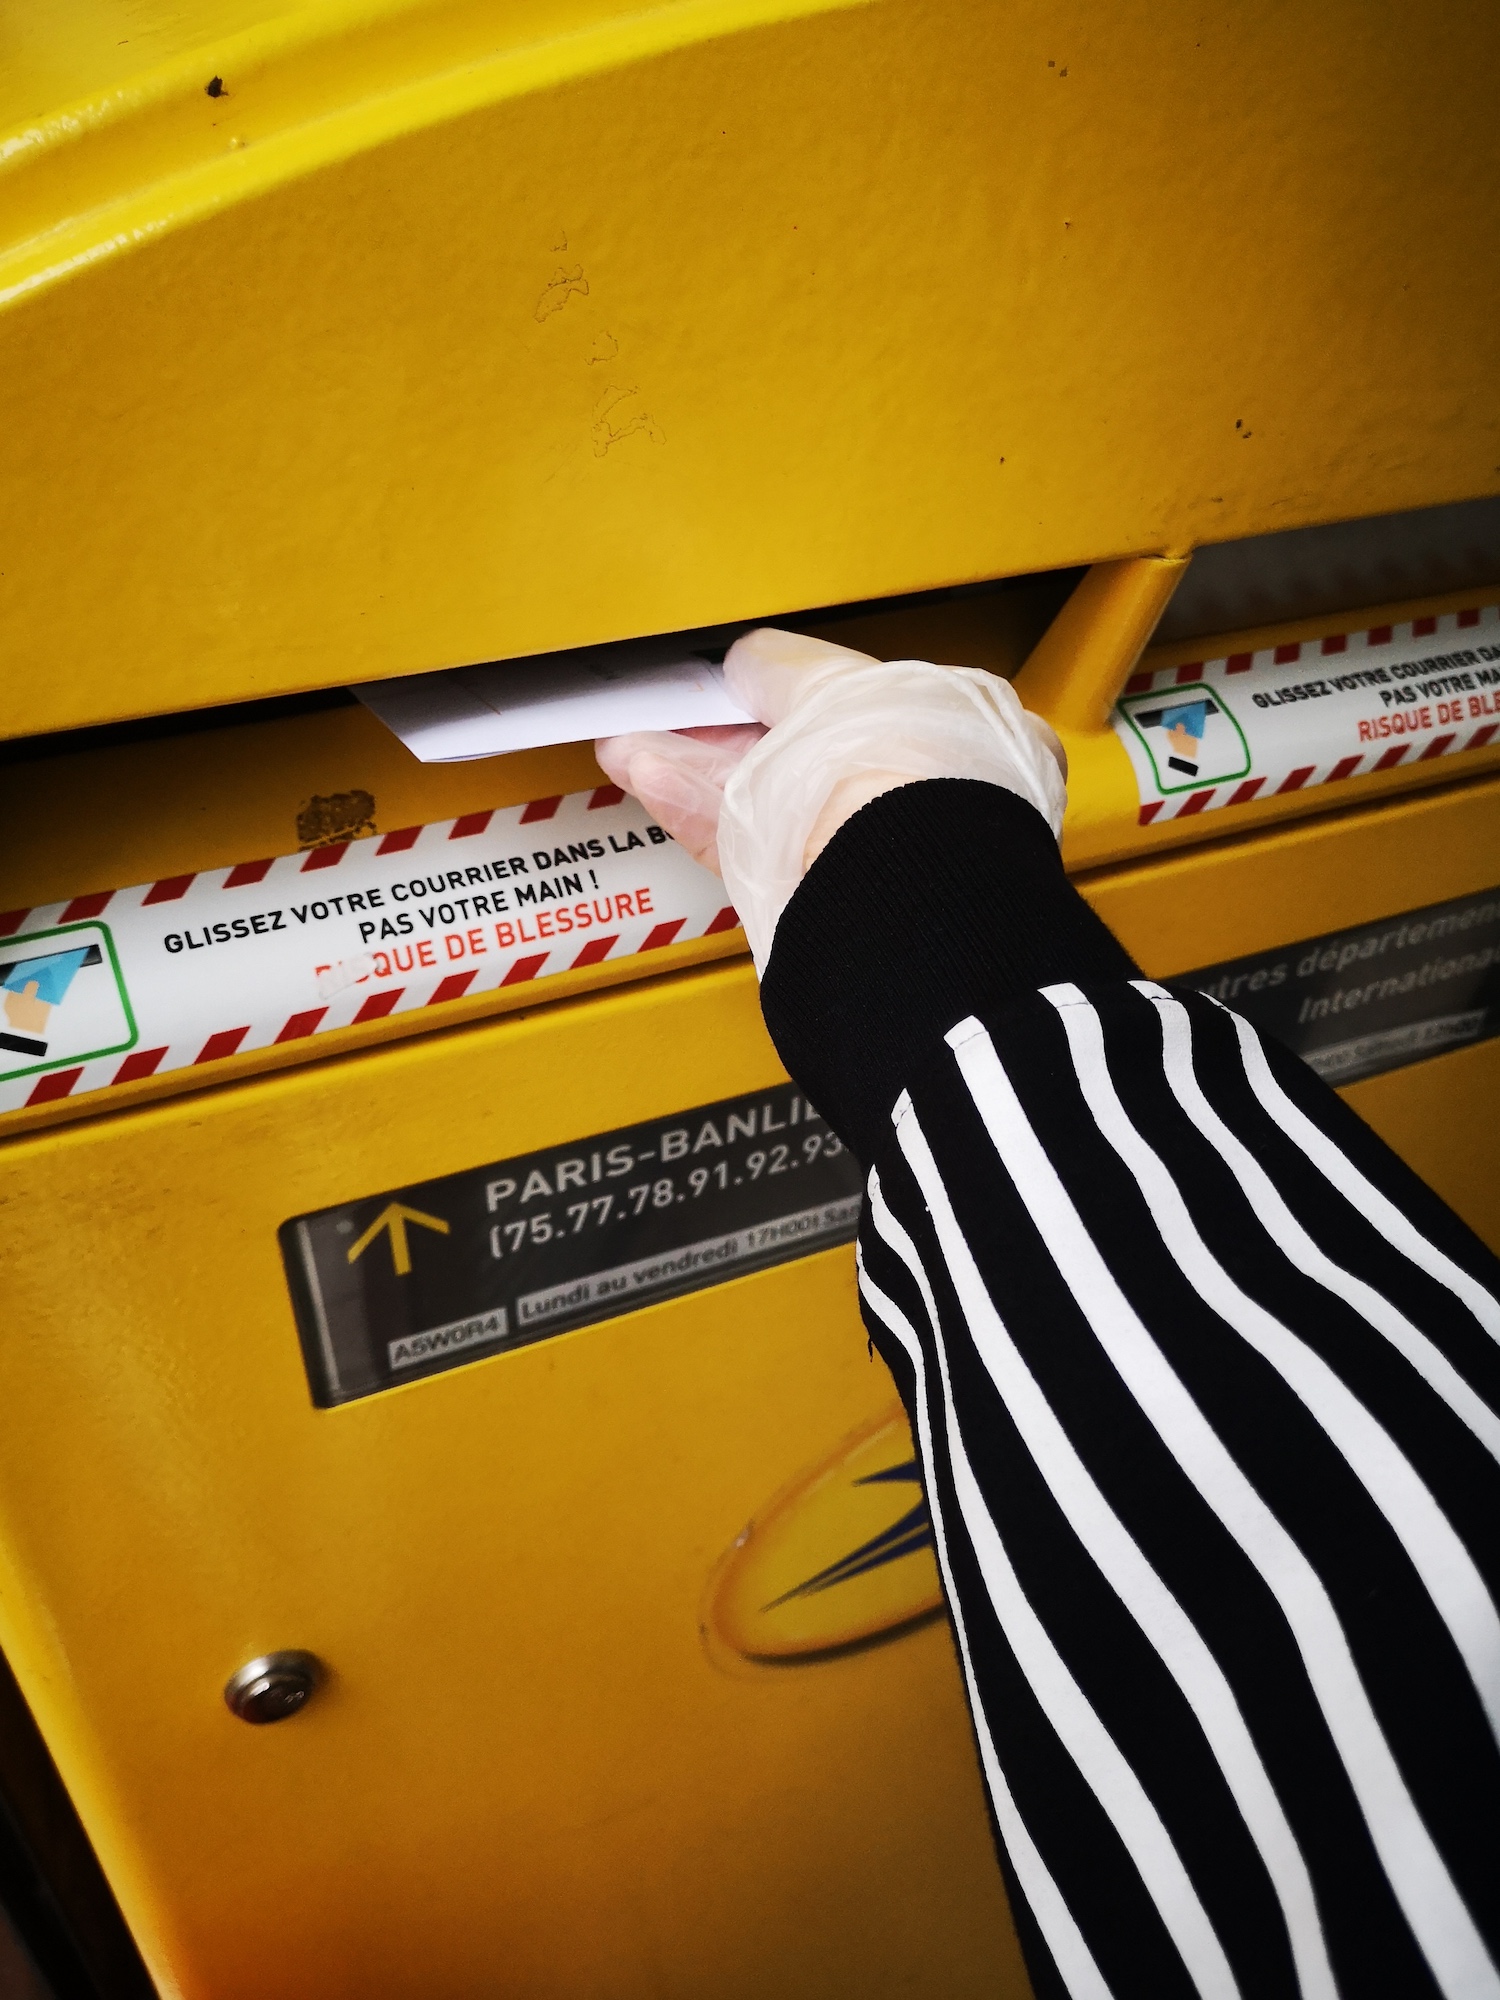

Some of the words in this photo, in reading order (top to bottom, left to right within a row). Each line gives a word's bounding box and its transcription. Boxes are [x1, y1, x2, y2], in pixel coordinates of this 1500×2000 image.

[1251, 681, 1332, 708] GLISSEZ
[1328, 667, 1391, 693] VOTRE
[1389, 649, 1481, 681] COURRIER
[1379, 685, 1418, 707] PAS
[1414, 672, 1477, 699] VOTRE
[1357, 705, 1433, 742] RISQUE
[1437, 699, 1465, 726] DE
[164, 910, 286, 953] GLISSEZ
[290, 888, 385, 924] VOTRE
[391, 856, 529, 902] COURRIER
[532, 838, 606, 871] DANS
[608, 830, 646, 854] LA
[646, 825, 675, 845] B
[358, 913, 414, 944] PAS
[419, 890, 510, 928] VOTRE
[514, 872, 583, 907] MAIN
[315, 940, 437, 983] QUE
[445, 928, 487, 961] DE
[495, 888, 654, 949] BLESSURE
[521, 1281, 590, 1320] Lundi
[596, 1272, 630, 1295] au
[633, 1236, 739, 1285] vendredi
